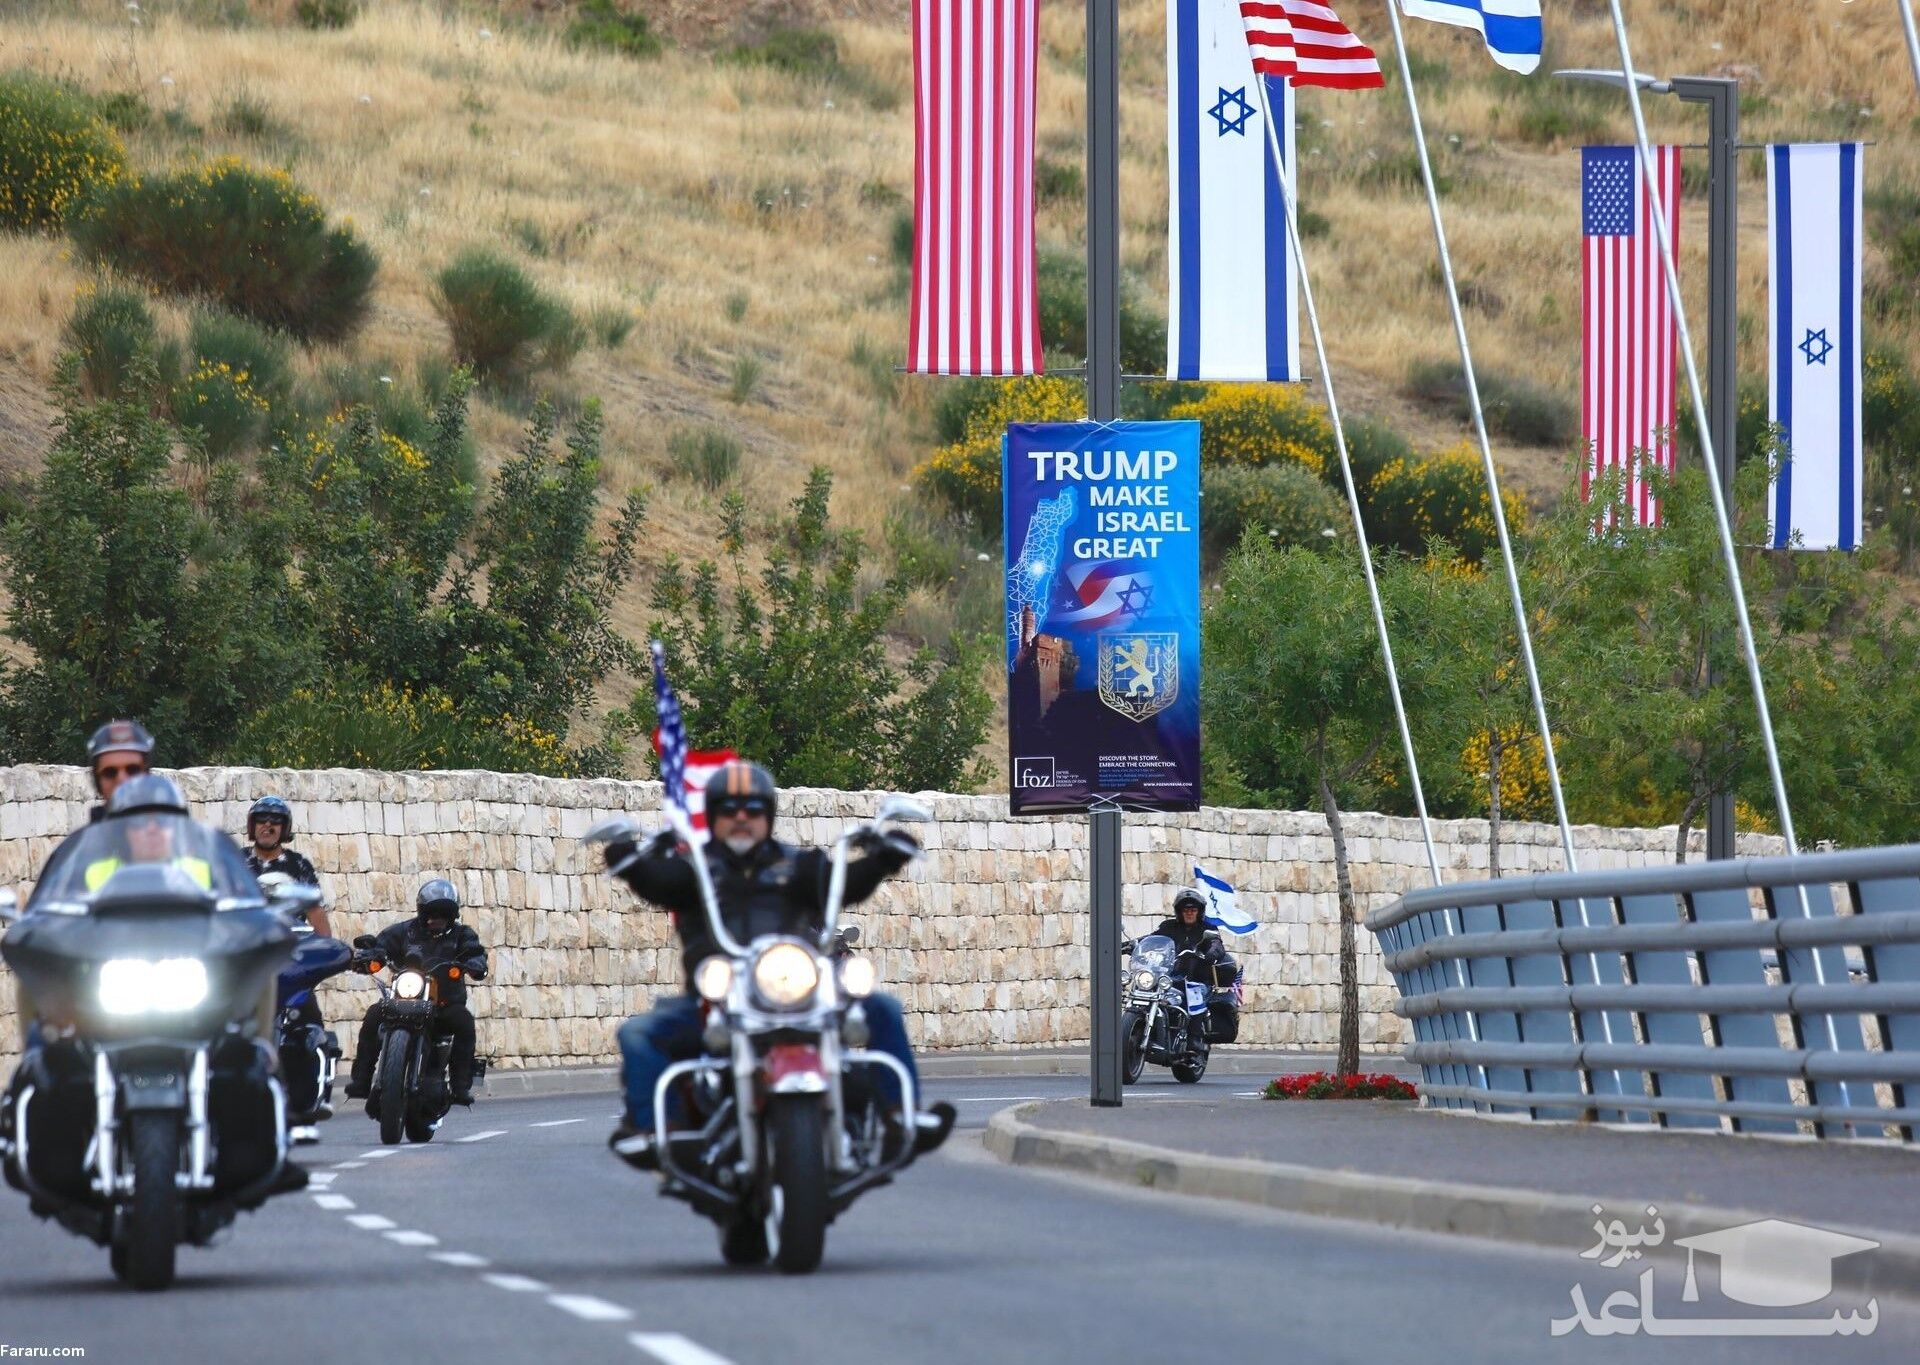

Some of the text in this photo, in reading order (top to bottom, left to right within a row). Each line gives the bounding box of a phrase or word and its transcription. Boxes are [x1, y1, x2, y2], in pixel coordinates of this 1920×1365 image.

[1028, 451, 1178, 481] TRUMP
[1090, 486, 1169, 506] MAKE
[1097, 512, 1191, 532] ISRAEL
[1073, 538, 1163, 559] GREAT
[1022, 768, 1051, 788] foz
